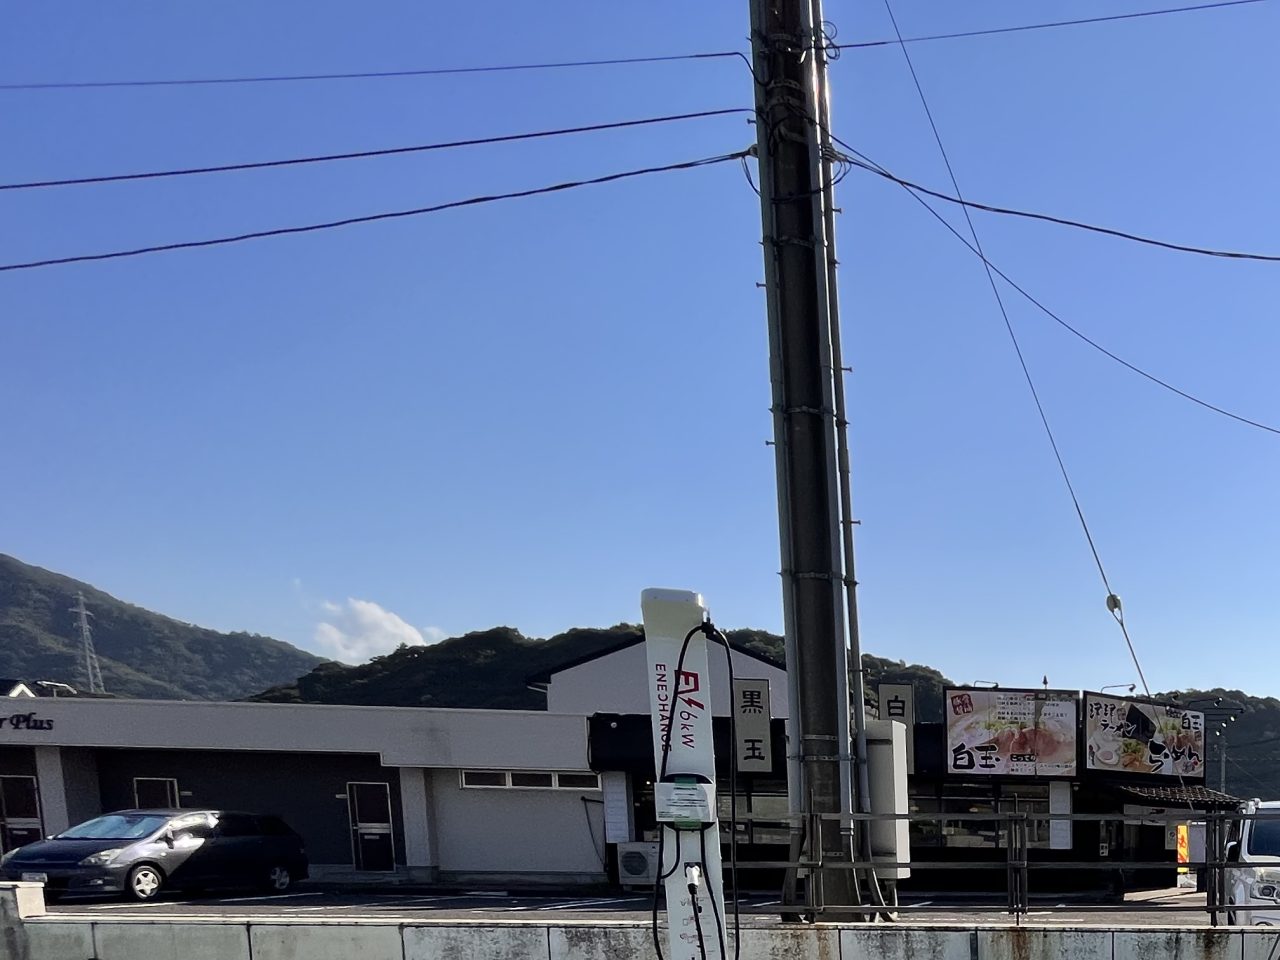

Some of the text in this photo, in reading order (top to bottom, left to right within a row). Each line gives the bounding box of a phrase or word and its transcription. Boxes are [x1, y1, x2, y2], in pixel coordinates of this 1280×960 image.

[9, 712, 54, 730] Plus
[680, 711, 698, 749] 6kW
[741, 690, 765, 760] 黒玉
[1181, 712, 1202, 730] 白玉
[952, 742, 1001, 769] 白玉
